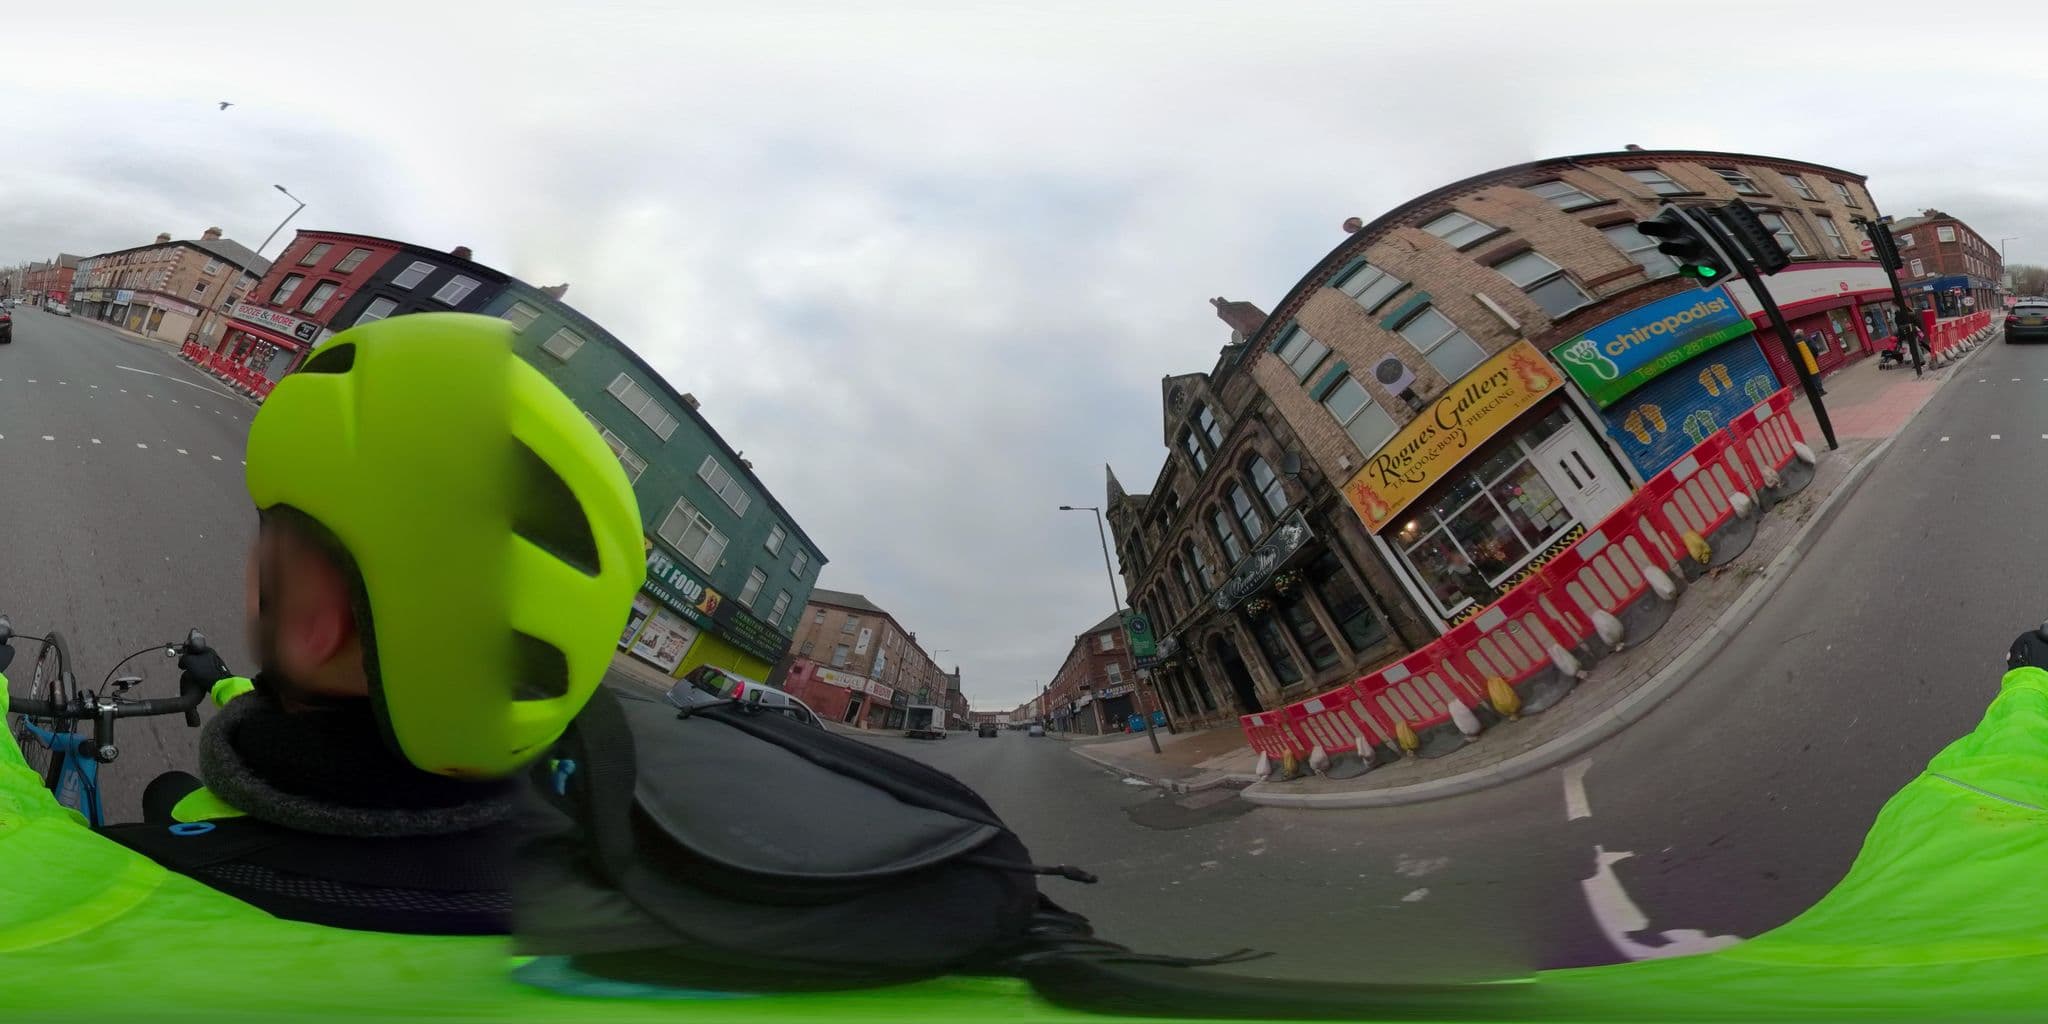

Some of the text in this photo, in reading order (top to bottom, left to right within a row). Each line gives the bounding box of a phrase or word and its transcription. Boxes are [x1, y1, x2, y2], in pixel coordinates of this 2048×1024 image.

[239, 305, 261, 317] BOOZE
[260, 310, 270, 320] &
[271, 313, 295, 328] MORE
[1605, 297, 1729, 356] chiropodist
[1656, 350, 1684, 369] 0151
[1683, 338, 1705, 355] 287
[1369, 367, 1510, 488] Rogues Gallery
[667, 568, 703, 601] FOOD
[652, 584, 671, 601] FOOD
[669, 595, 700, 621] AVAILABLE
